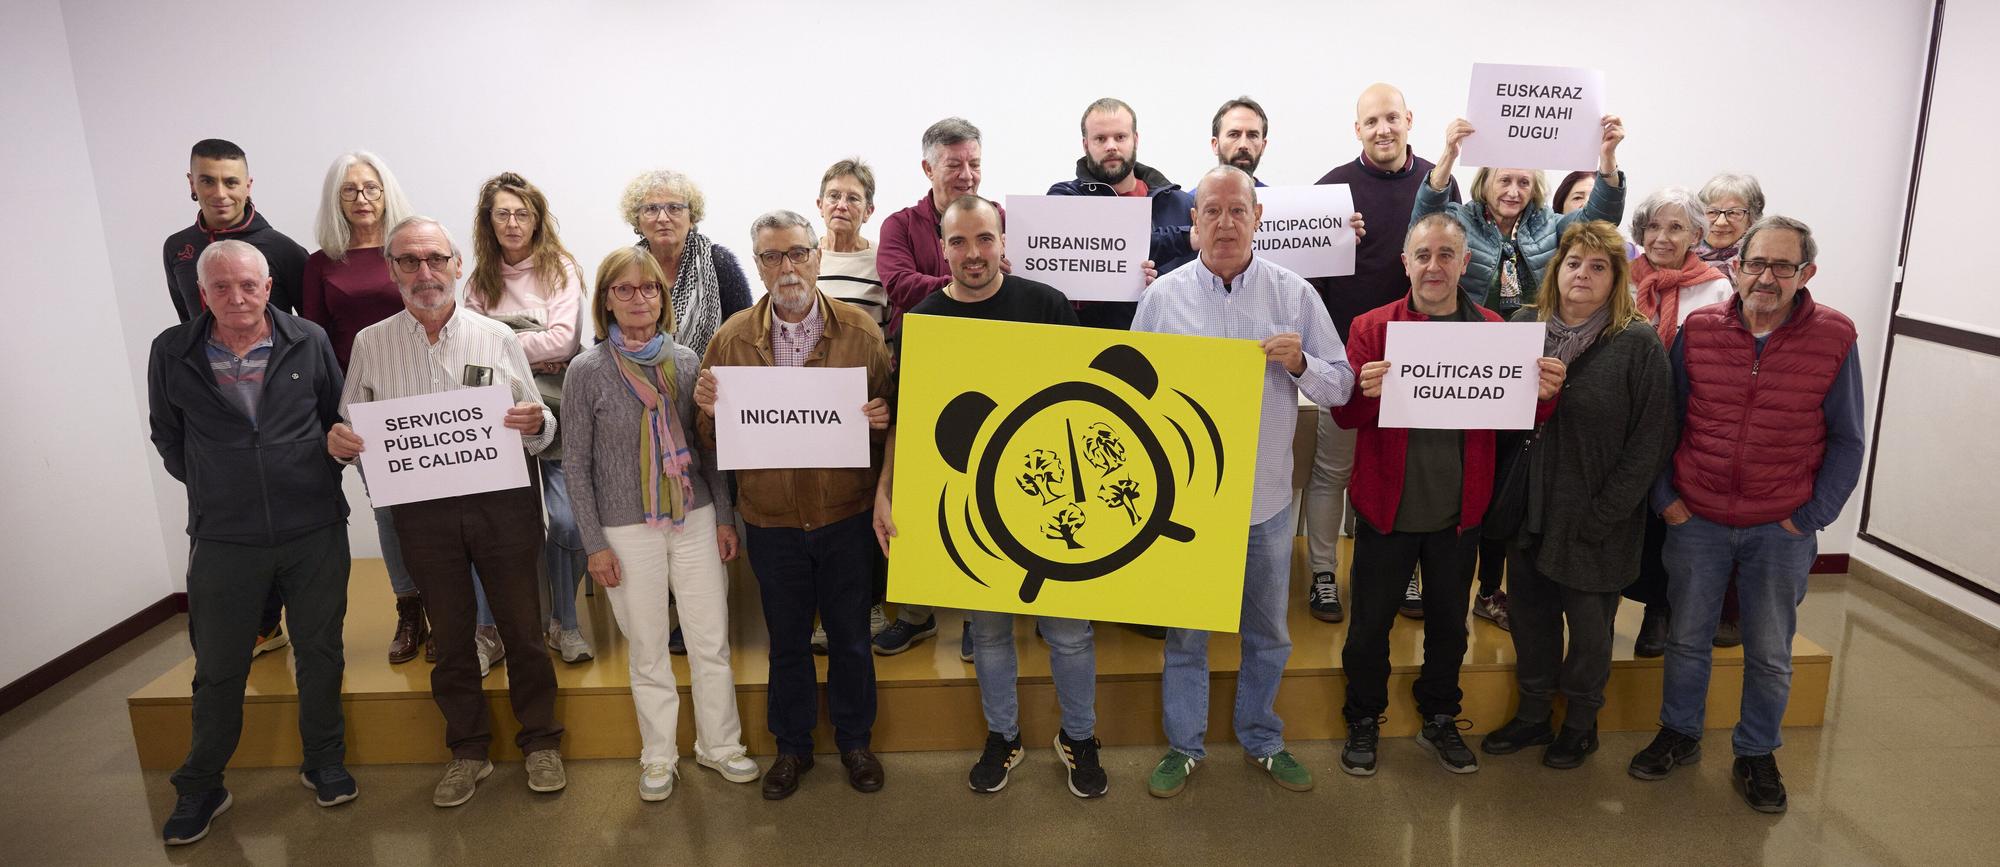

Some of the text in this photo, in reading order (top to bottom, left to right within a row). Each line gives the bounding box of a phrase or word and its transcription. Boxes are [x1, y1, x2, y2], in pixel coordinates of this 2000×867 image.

[1496, 83, 1583, 100] EUSKARAZ
[1500, 104, 1573, 120] BIZI NAHI
[1508, 125, 1560, 140] DUGU!
[1253, 214, 1343, 233] RTICIPACIÓN
[1027, 235, 1127, 252] URBANISMO
[1024, 257, 1127, 274] SOSTENIBLE
[1400, 361, 1523, 379] POLÍTICAS DE
[1413, 385, 1505, 400] IGUALDAD
[384, 406, 484, 432] SERVICIOS
[740, 409, 842, 425] INICIATIVA
[383, 425, 493, 453] PÚBLICOS Y
[387, 446, 498, 473] DE CALIDAD
